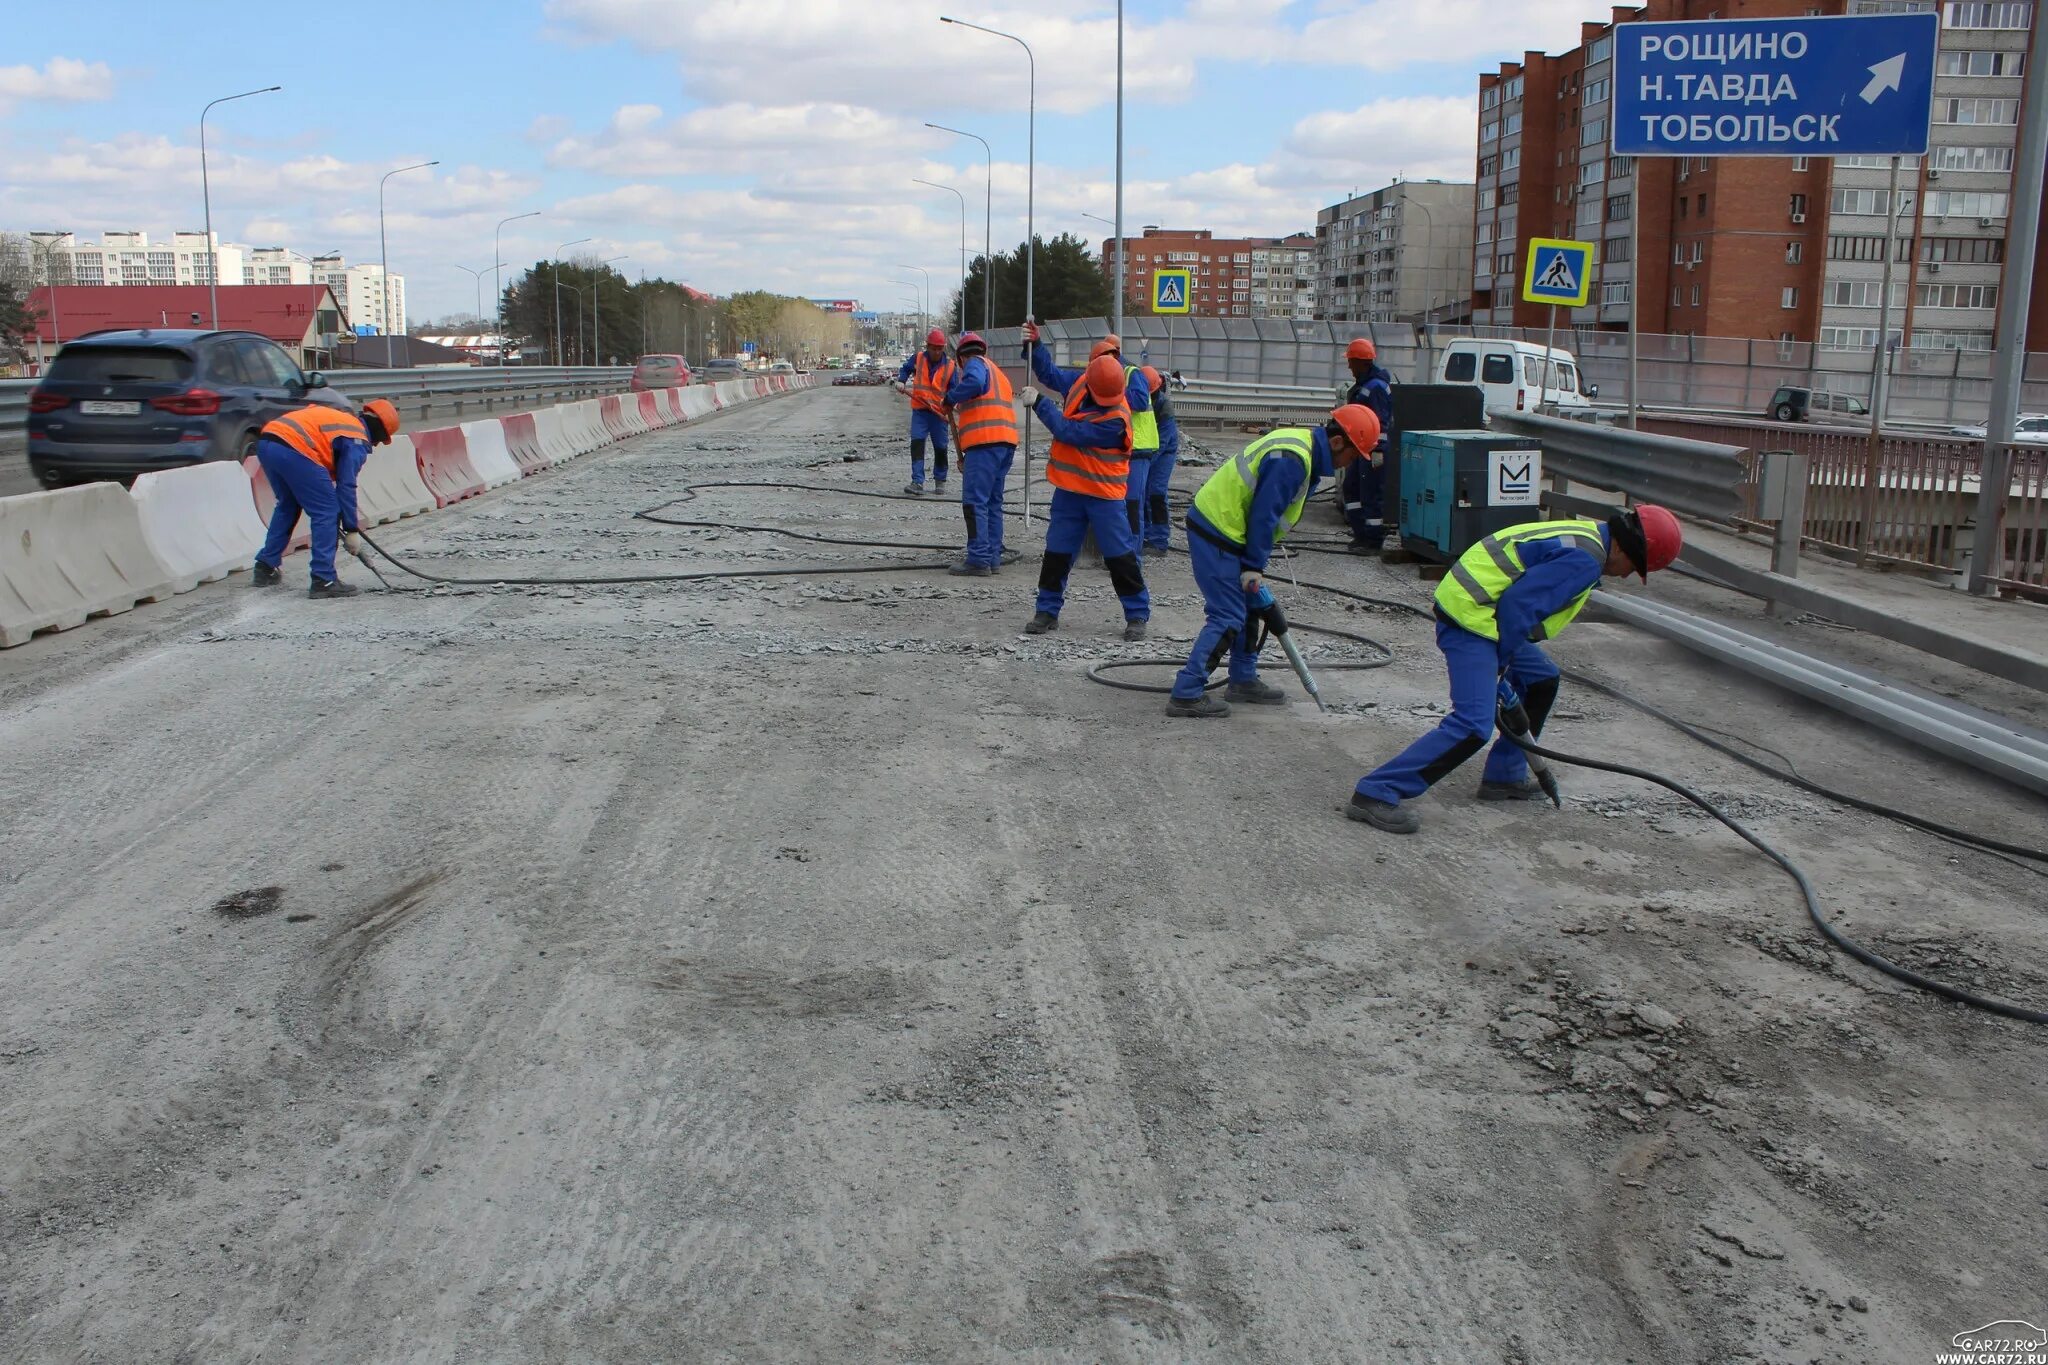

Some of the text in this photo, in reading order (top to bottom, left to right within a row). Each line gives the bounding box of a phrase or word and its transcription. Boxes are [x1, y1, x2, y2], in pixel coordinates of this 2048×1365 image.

[1640, 32, 1808, 65] РОЩИНО
[1640, 73, 1798, 106] Н.ТАВДА
[1640, 114, 1841, 142] ТОБОЛЬСК
